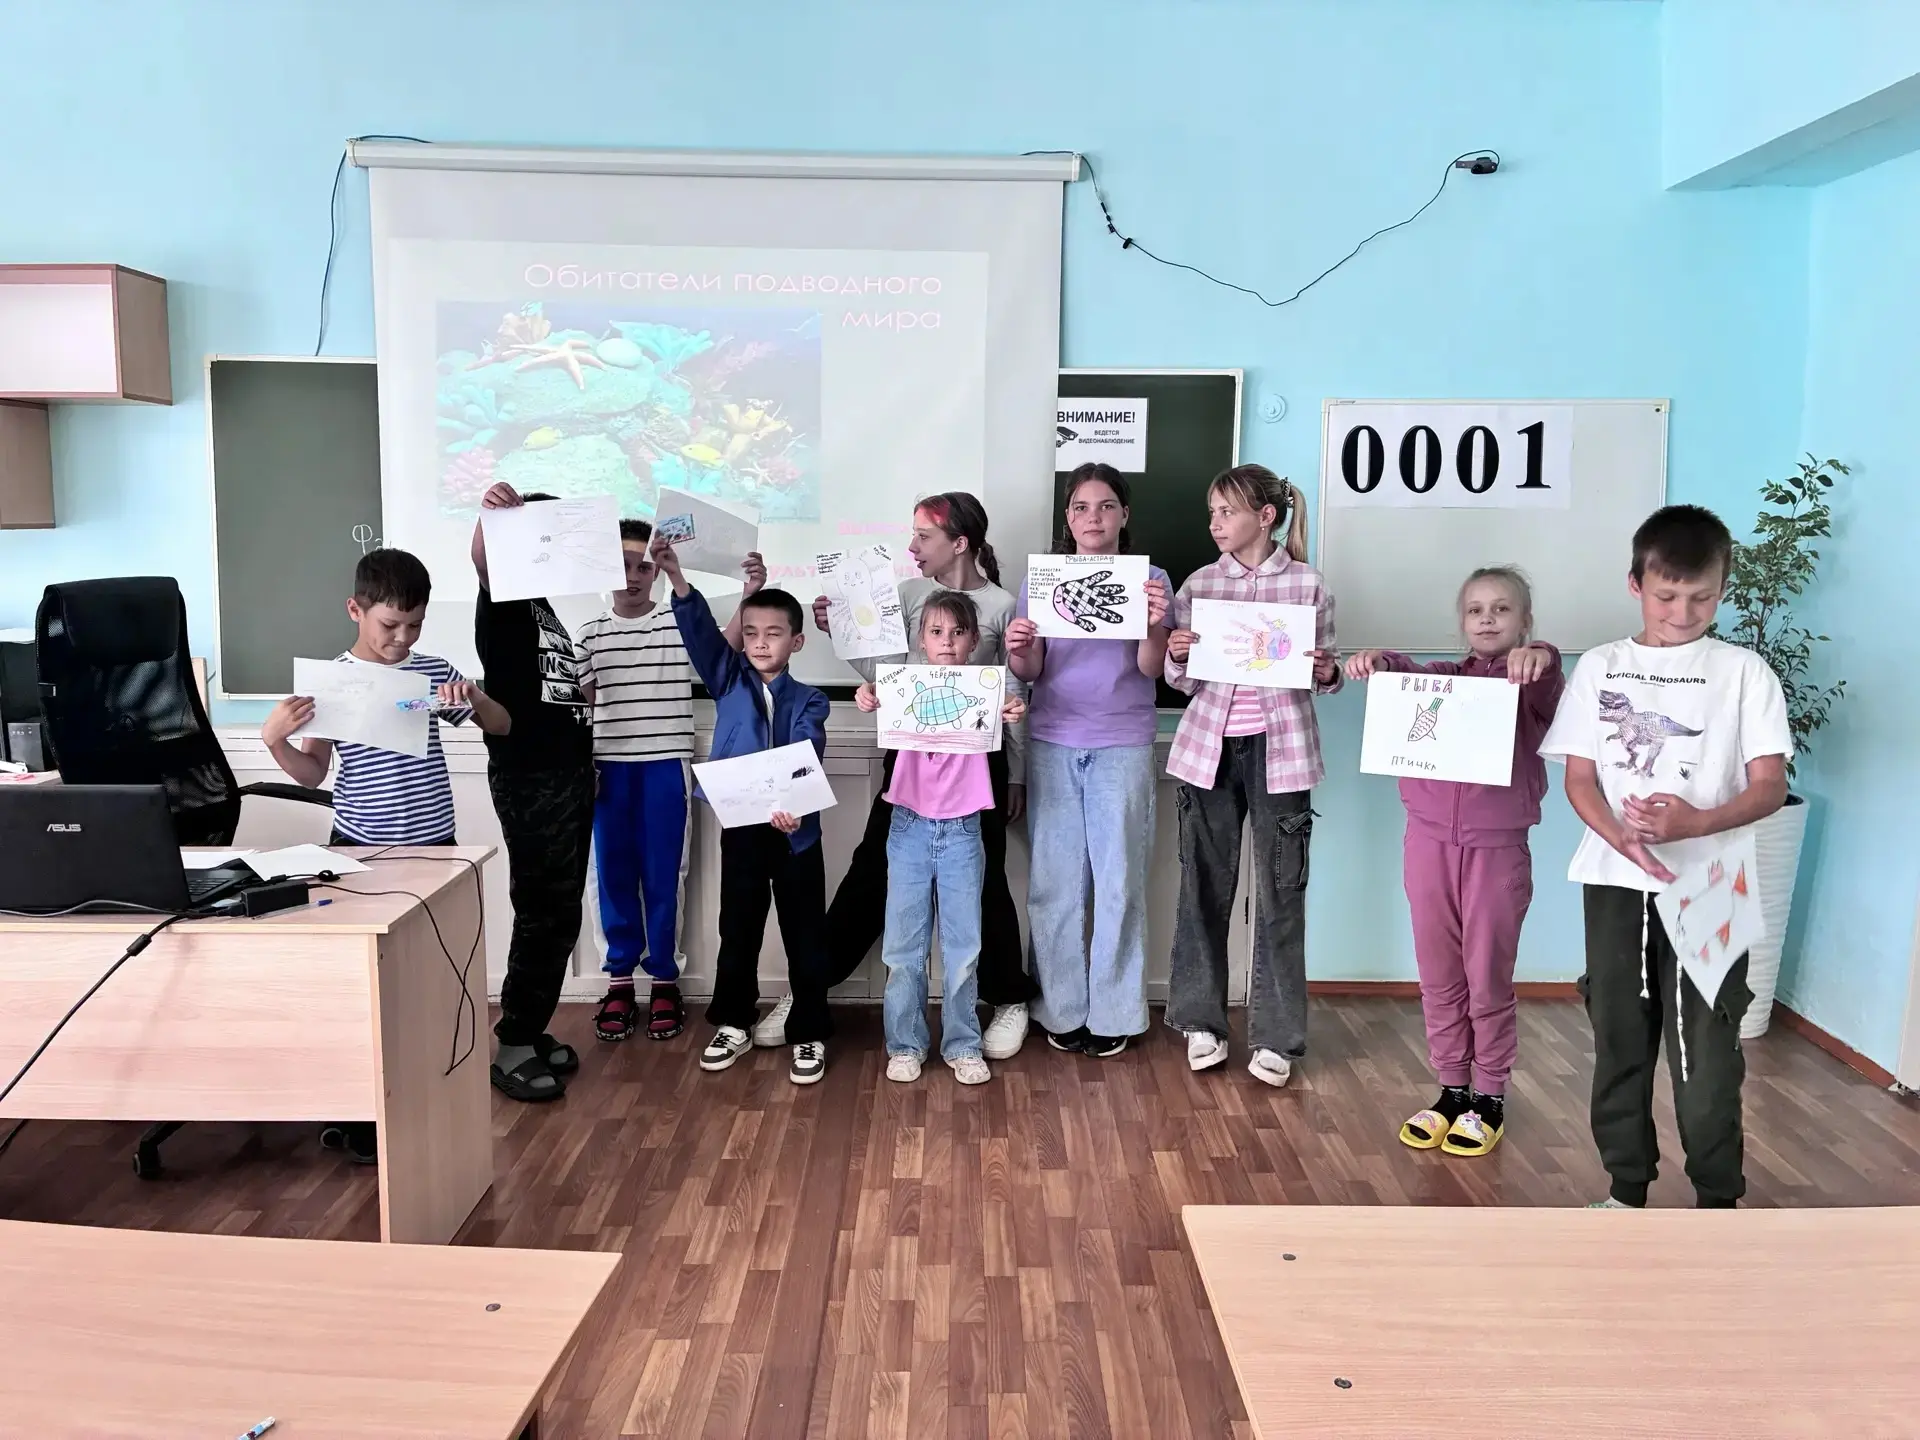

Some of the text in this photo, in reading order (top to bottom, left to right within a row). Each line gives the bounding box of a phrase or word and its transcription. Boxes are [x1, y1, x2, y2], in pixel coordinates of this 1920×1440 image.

[523, 263, 942, 296] Обитатели подводного
[841, 309, 941, 333] мира
[1057, 411, 1136, 423] ВНИМАНИЕ!
[1341, 420, 1552, 494] 0001
[1401, 676, 1453, 693] РЫБА
[1649, 674, 1706, 684] DINOSAURS
[46, 824, 82, 832] ASUS
